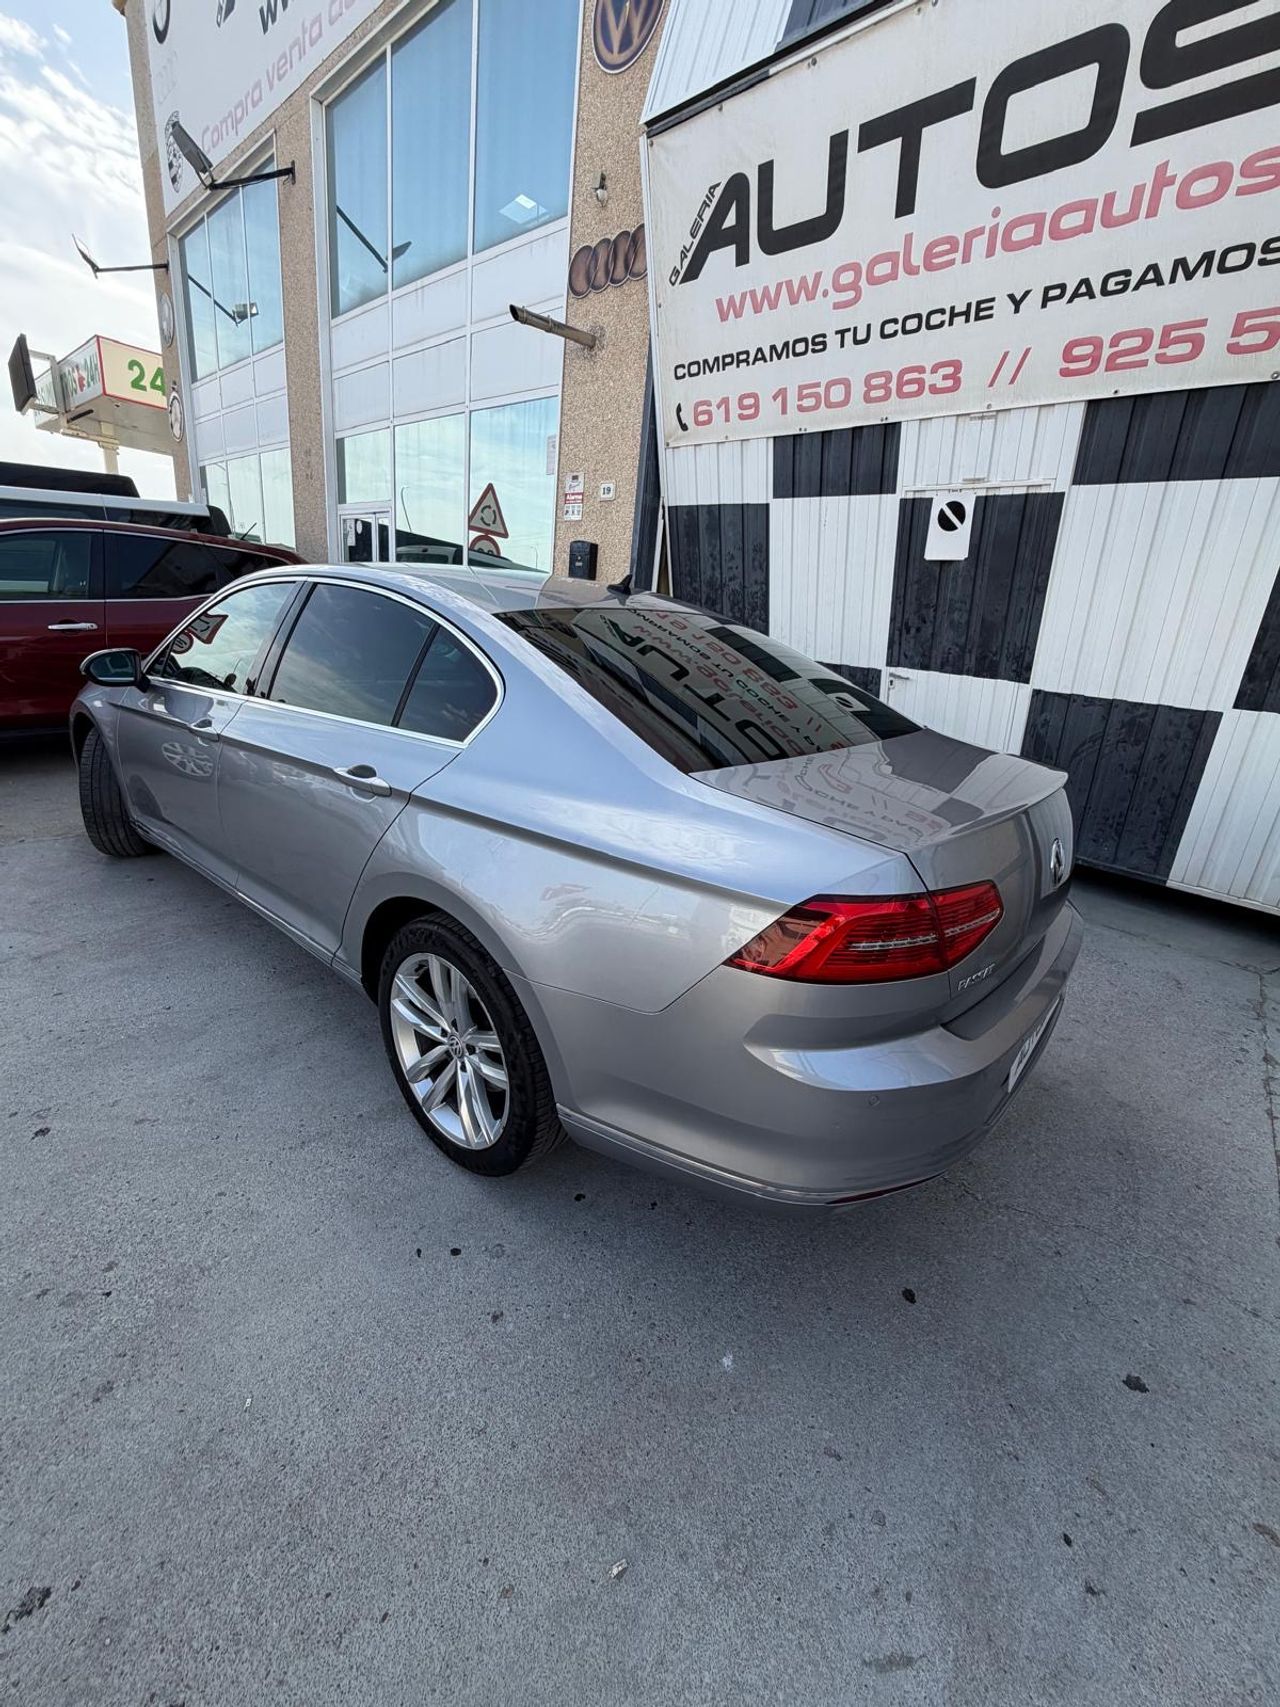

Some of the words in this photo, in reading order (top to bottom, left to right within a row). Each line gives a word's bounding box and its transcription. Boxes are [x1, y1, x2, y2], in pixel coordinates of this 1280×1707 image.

[201, 79, 263, 153] Compra
[266, 13, 322, 90] venta
[679, 0, 1280, 285] AUTOS
[668, 181, 722, 287] GALERIA
[715, 145, 1280, 322] www.galeriaautos
[127, 359, 166, 397] 24
[674, 333, 827, 380] COMPRAMOS
[834, 323, 872, 349] TU
[879, 296, 996, 340] COCHE
[1006, 289, 1033, 315] Y
[692, 391, 761, 427] 619
[771, 377, 852, 416] 150
[862, 358, 963, 404] 863
[1058, 317, 1209, 378] 925
[1226, 306, 1280, 356] 5
[602, 486, 612, 495] 19
